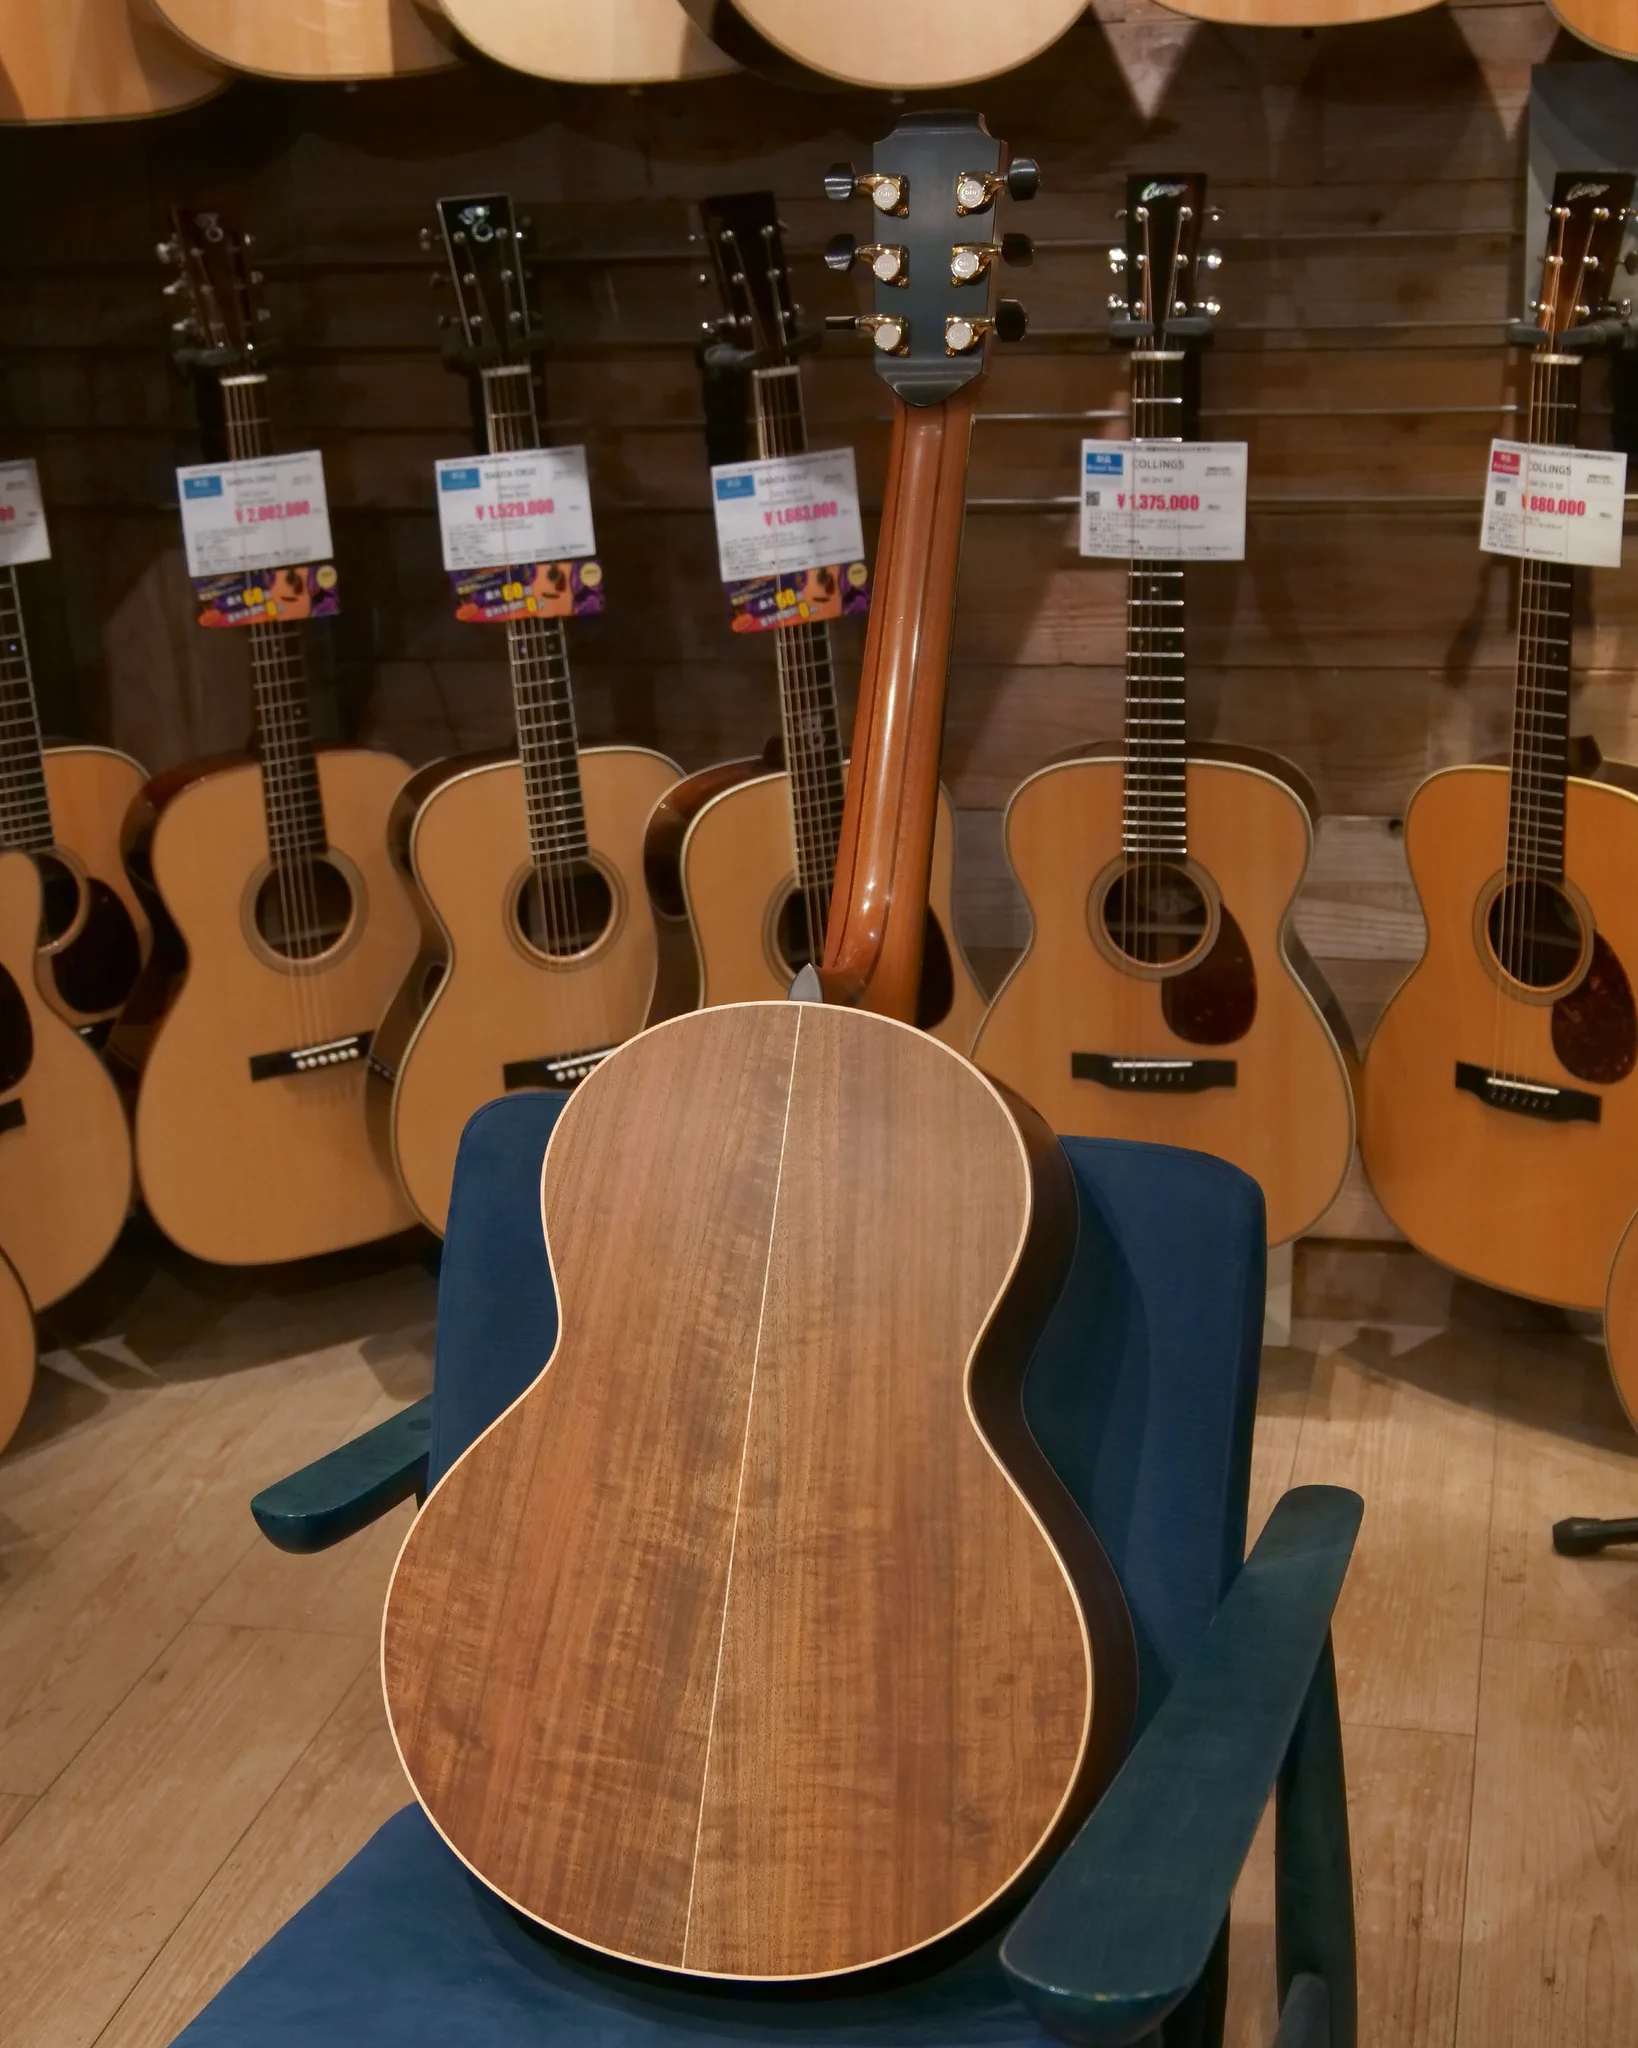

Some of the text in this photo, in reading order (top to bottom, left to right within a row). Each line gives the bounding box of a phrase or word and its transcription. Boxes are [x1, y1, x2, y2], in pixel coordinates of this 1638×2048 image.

[1132, 458, 1186, 471] COLLINGS
[1529, 461, 1573, 477] COLLINGS
[1530, 495, 1587, 517] 880,000
